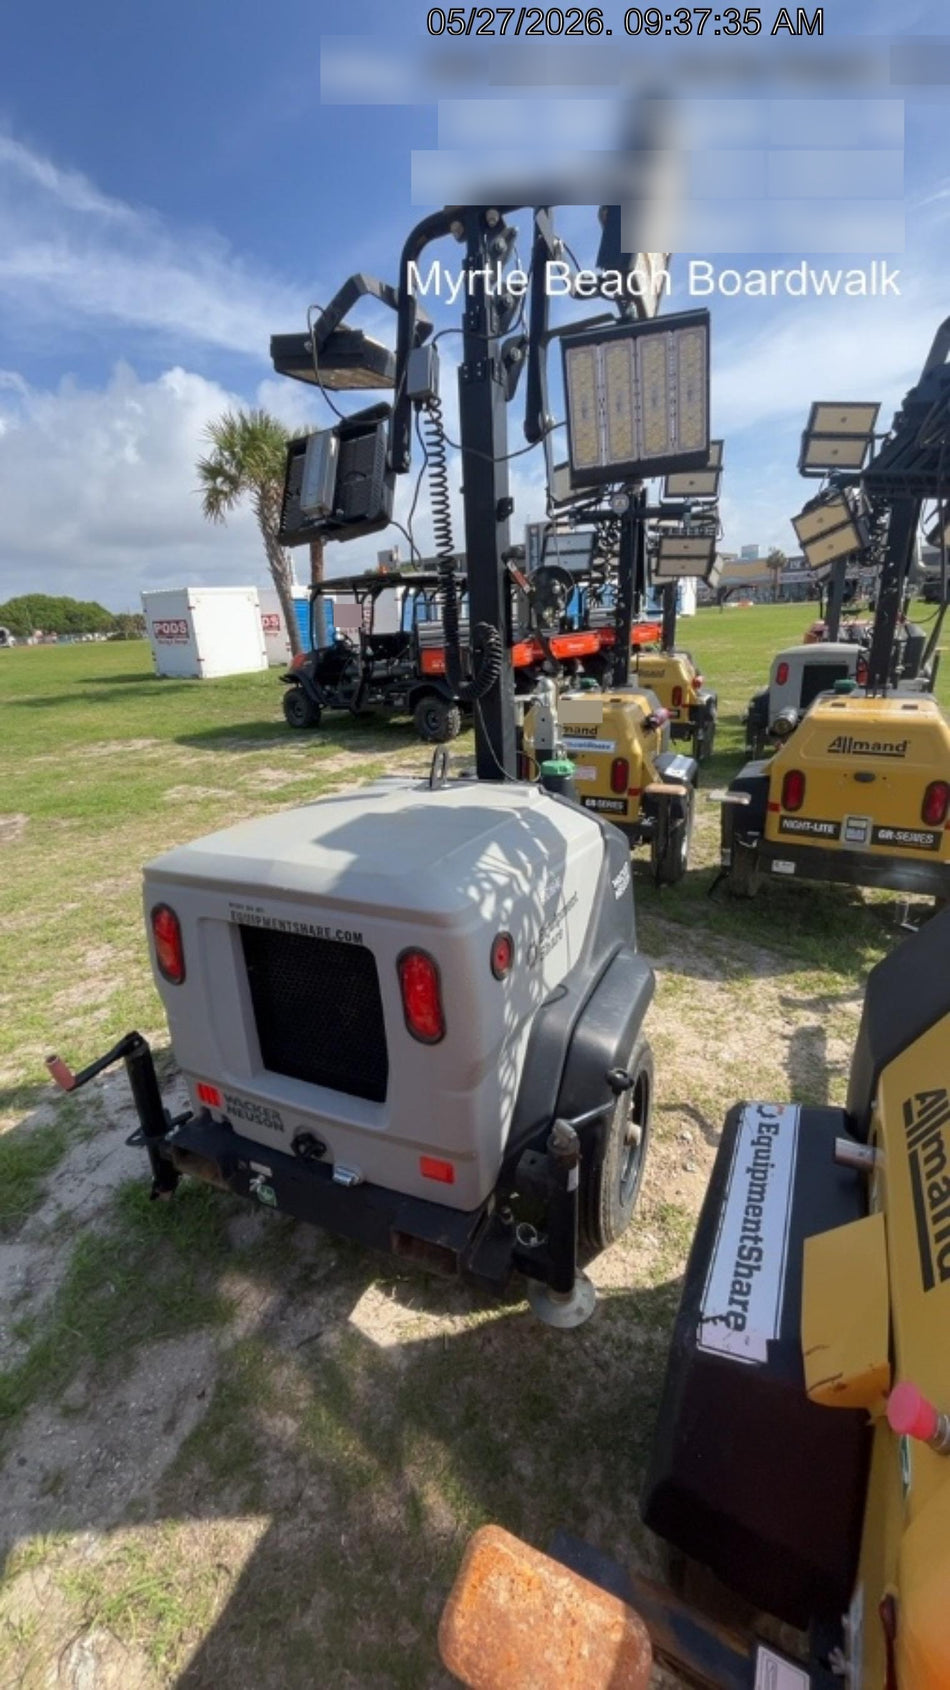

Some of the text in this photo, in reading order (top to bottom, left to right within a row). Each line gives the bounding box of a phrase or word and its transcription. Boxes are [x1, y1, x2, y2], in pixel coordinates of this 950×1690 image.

[154, 621, 188, 635] PODS
[827, 735, 909, 757] Allmand
[782, 819, 835, 834] NIGHT-LITE
[877, 829, 934, 844] GR-SERIES
[229, 910, 363, 943] EQUIPMENTSHARE.COM
[726, 1122, 780, 1332] EquipmentShare
